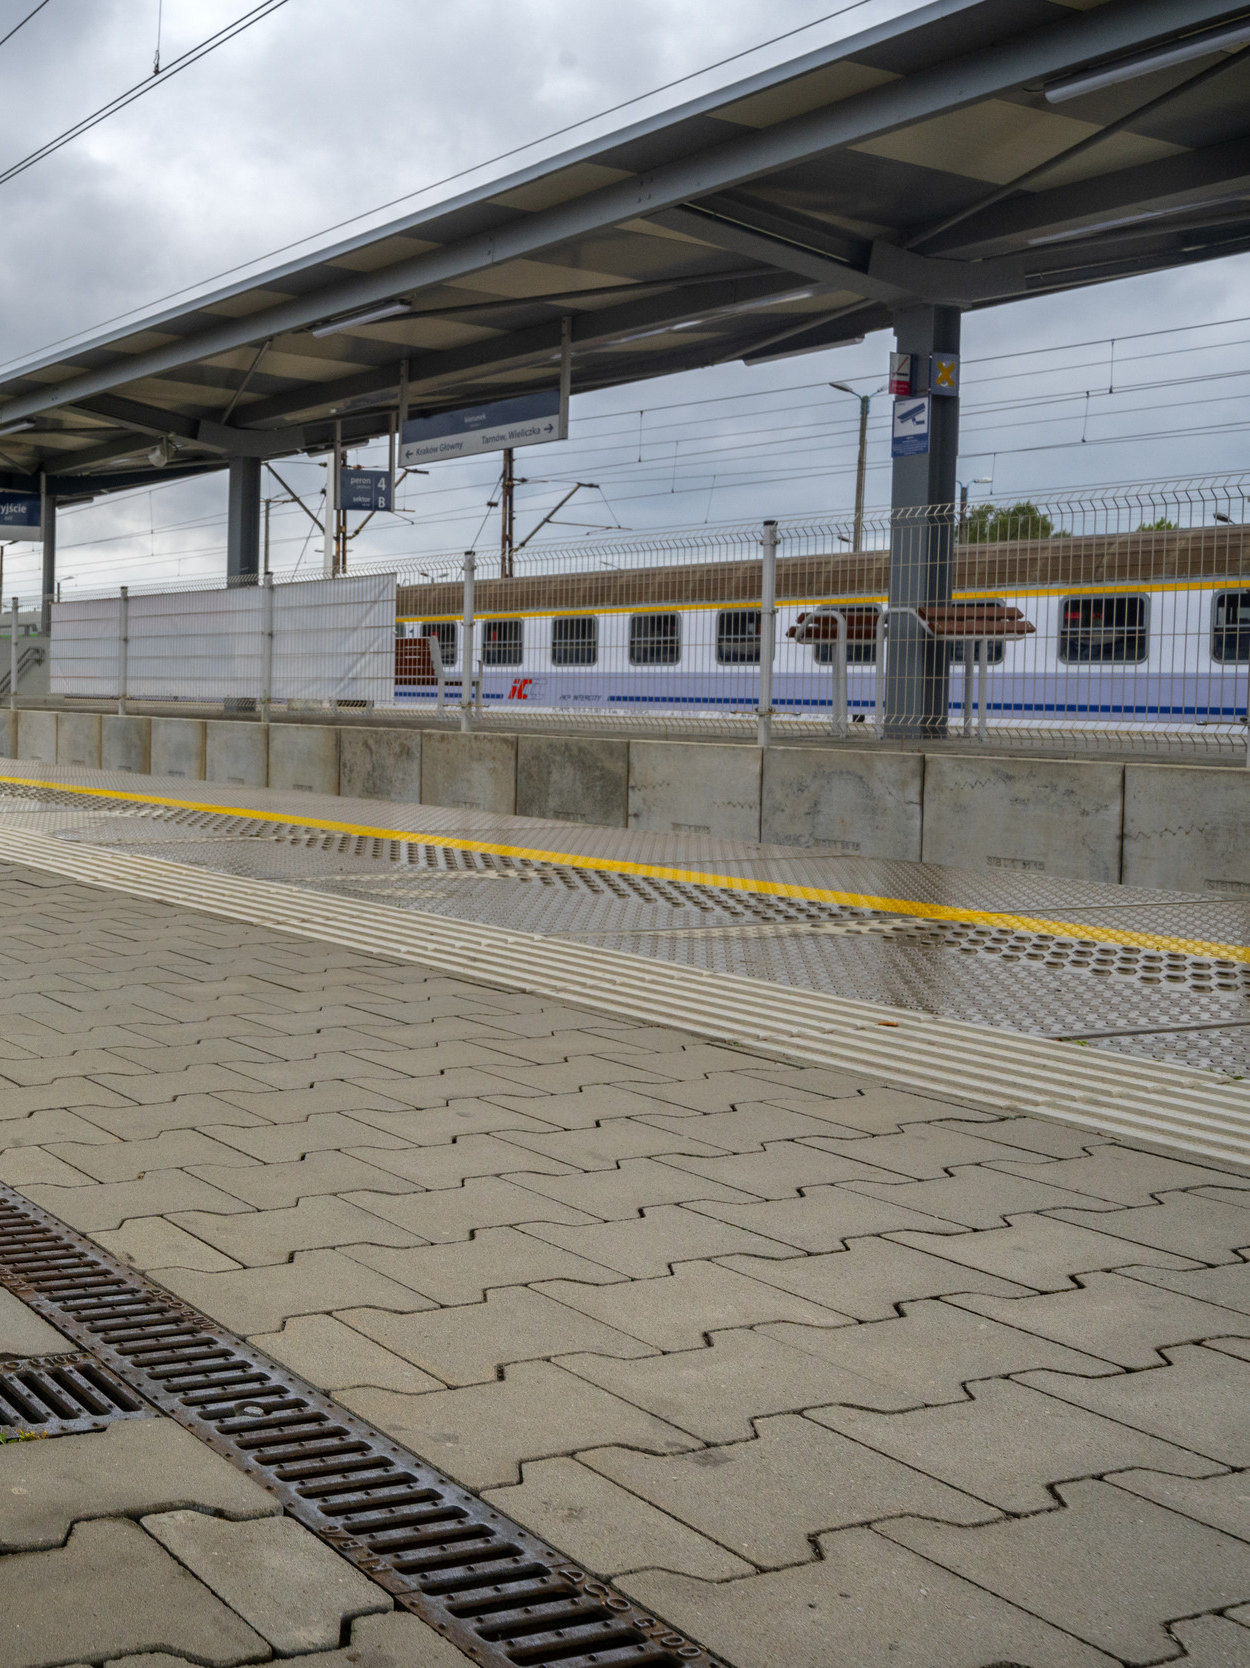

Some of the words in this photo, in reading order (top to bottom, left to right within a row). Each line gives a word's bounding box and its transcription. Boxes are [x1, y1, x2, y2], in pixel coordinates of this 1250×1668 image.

[508, 426, 541, 439] Wieliczka
[416, 445, 438, 456] Kraków
[440, 442, 463, 452] Główny
[350, 477, 371, 485] peron
[377, 477, 386, 490] 4
[378, 496, 386, 508] B
[559, 1569, 631, 1612] ACO
